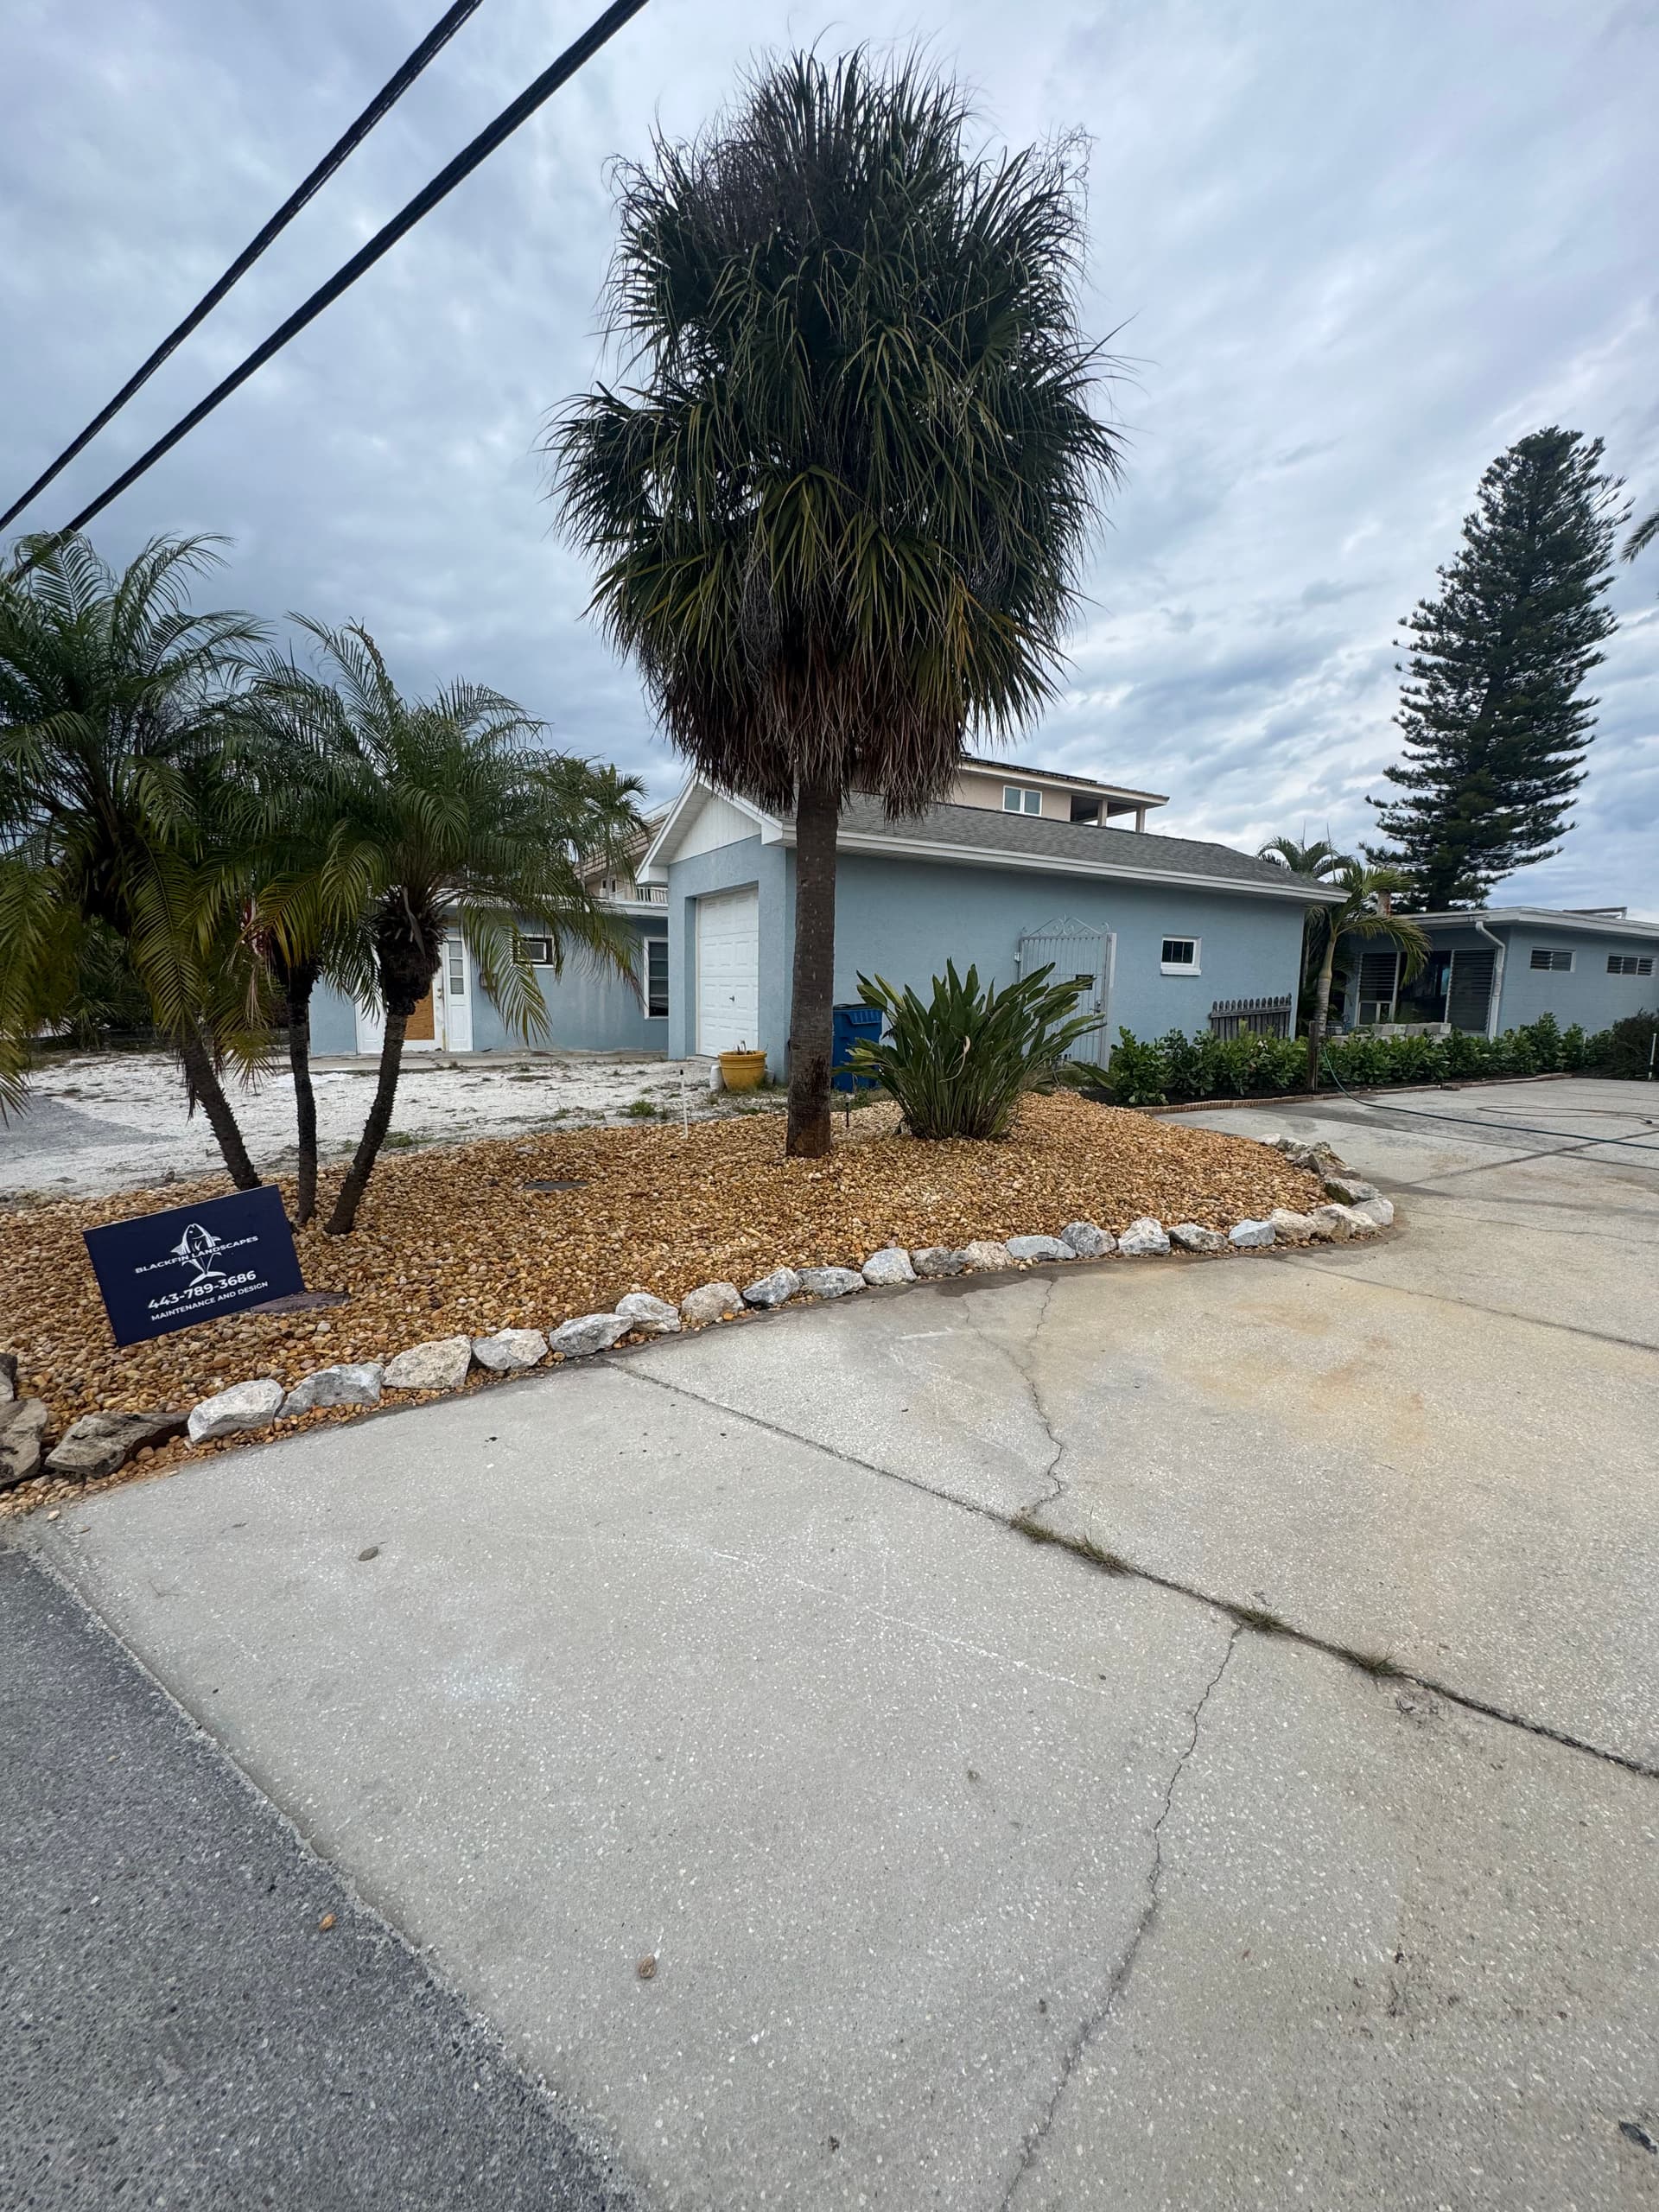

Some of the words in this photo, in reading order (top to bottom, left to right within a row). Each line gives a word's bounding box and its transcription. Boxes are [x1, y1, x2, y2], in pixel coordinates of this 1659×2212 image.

[135, 1255, 189, 1274] BLACKFIN
[191, 1236, 259, 1258] LANDSCAPES
[148, 1270, 257, 1309] 443-789-3686
[150, 1297, 216, 1321] MAINTENANCE
[217, 1291, 237, 1302] AND
[238, 1281, 269, 1295] DESIGN
